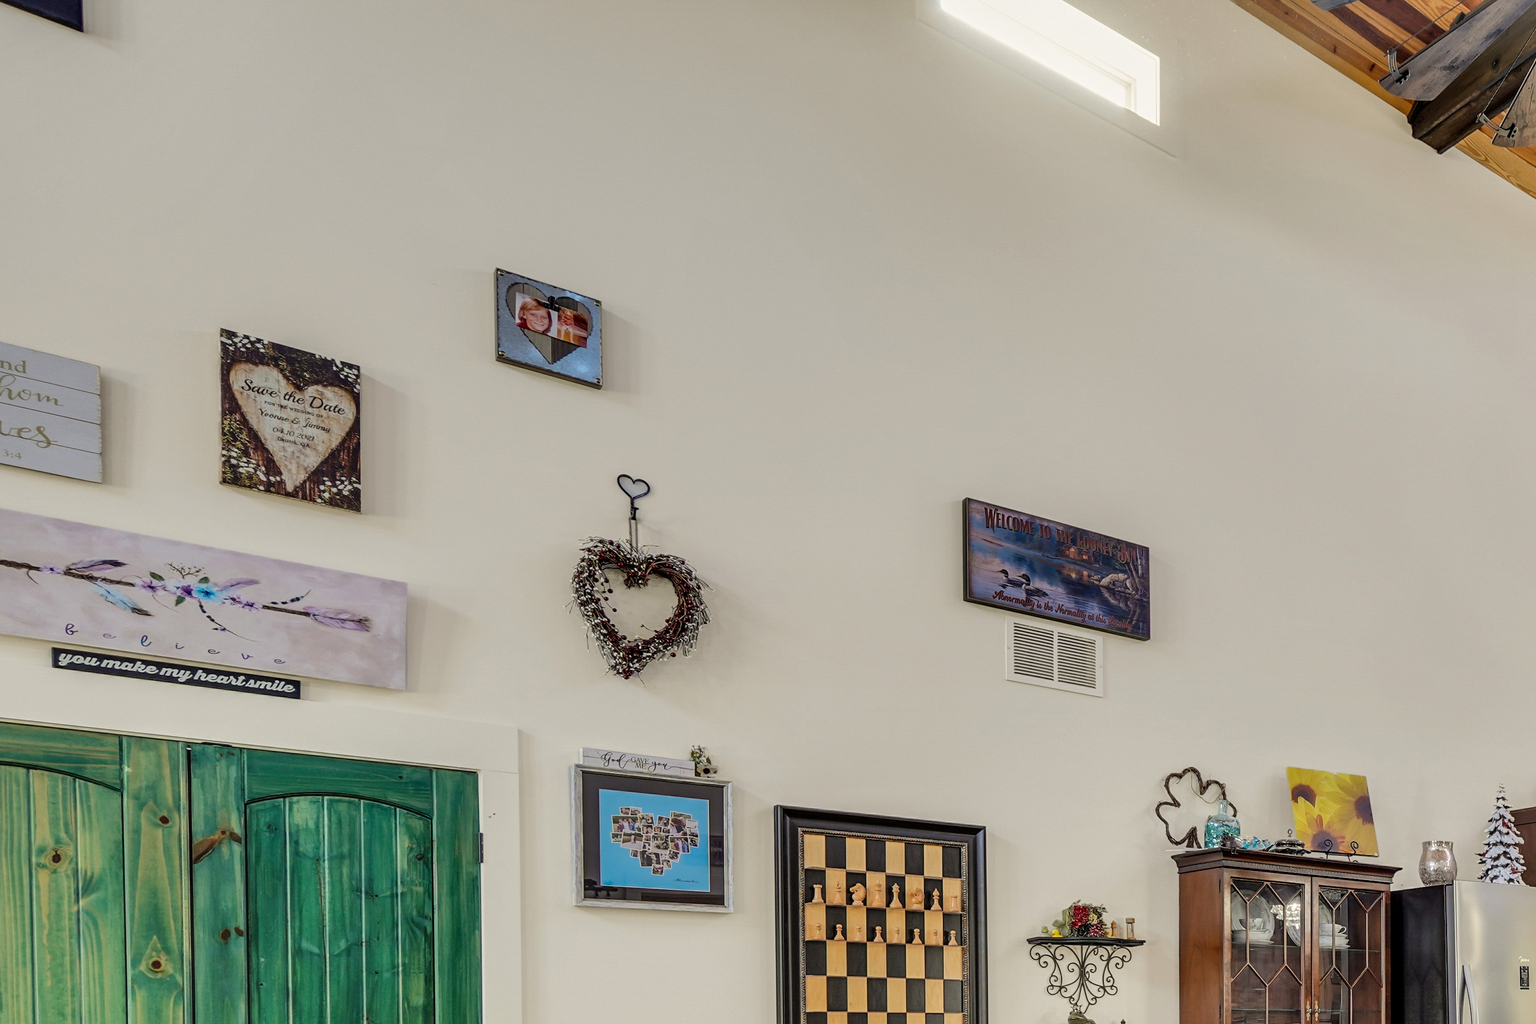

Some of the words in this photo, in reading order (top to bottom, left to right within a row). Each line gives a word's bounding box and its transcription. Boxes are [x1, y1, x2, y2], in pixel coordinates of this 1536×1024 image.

[241, 378, 278, 398] Save
[283, 390, 305, 405] the
[308, 395, 346, 415] Date
[291, 417, 300, 425] &
[3, 449, 22, 460] 3:4
[1044, 601, 1053, 612] the
[1055, 604, 1087, 623] Normality
[58, 652, 100, 667] you
[101, 658, 158, 675] make
[160, 668, 192, 682] my
[193, 669, 246, 687] heart
[245, 679, 295, 693] smile
[601, 751, 630, 769] God
[648, 761, 672, 772] you
